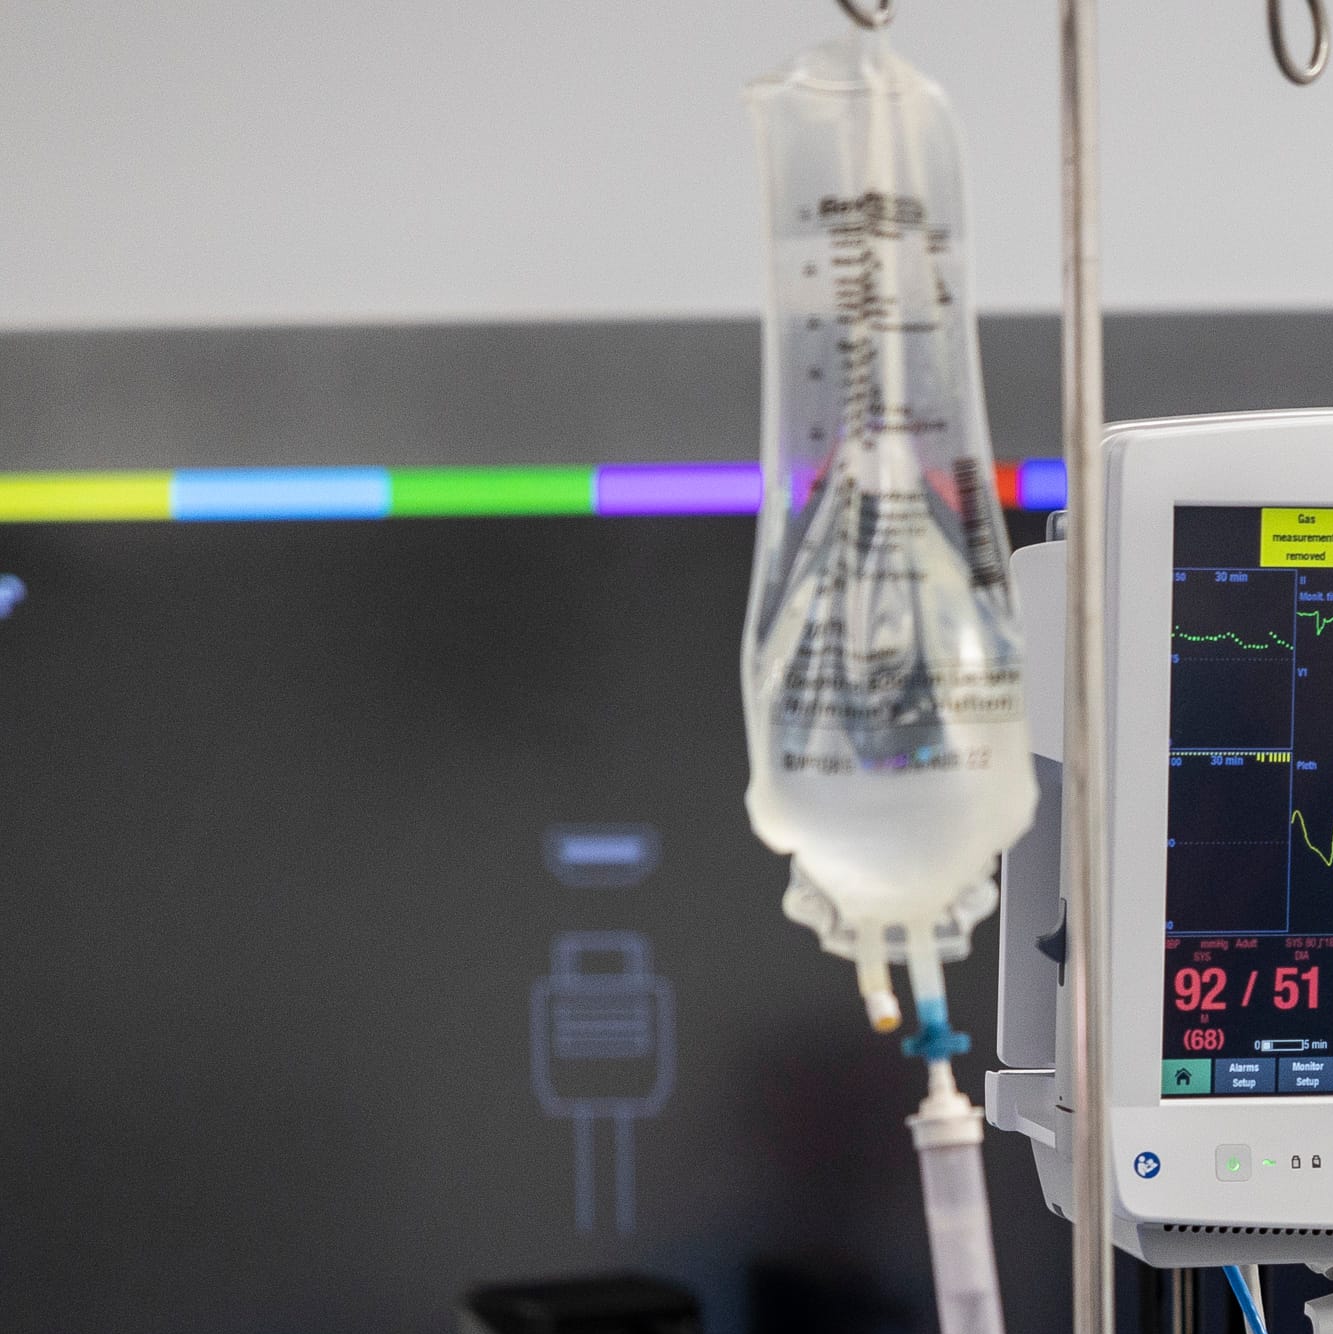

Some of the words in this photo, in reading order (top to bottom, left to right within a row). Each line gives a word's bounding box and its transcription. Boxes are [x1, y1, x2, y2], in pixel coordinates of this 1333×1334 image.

[1298, 515, 1316, 524] Gas
[1286, 551, 1326, 560] removed
[1215, 573, 1227, 582] 30
[1230, 573, 1248, 582] min
[1211, 757, 1222, 765] 30
[1225, 757, 1243, 765] min
[1174, 967, 1227, 1011] 92
[1273, 966, 1319, 1009] 51
[1184, 1029, 1225, 1051] (68)
[1312, 1040, 1327, 1049] min
[1229, 1063, 1259, 1072] Alarms
[1293, 1062, 1323, 1071] Monitor
[1233, 1078, 1255, 1088] Setup
[1296, 1077, 1319, 1087] Setup
